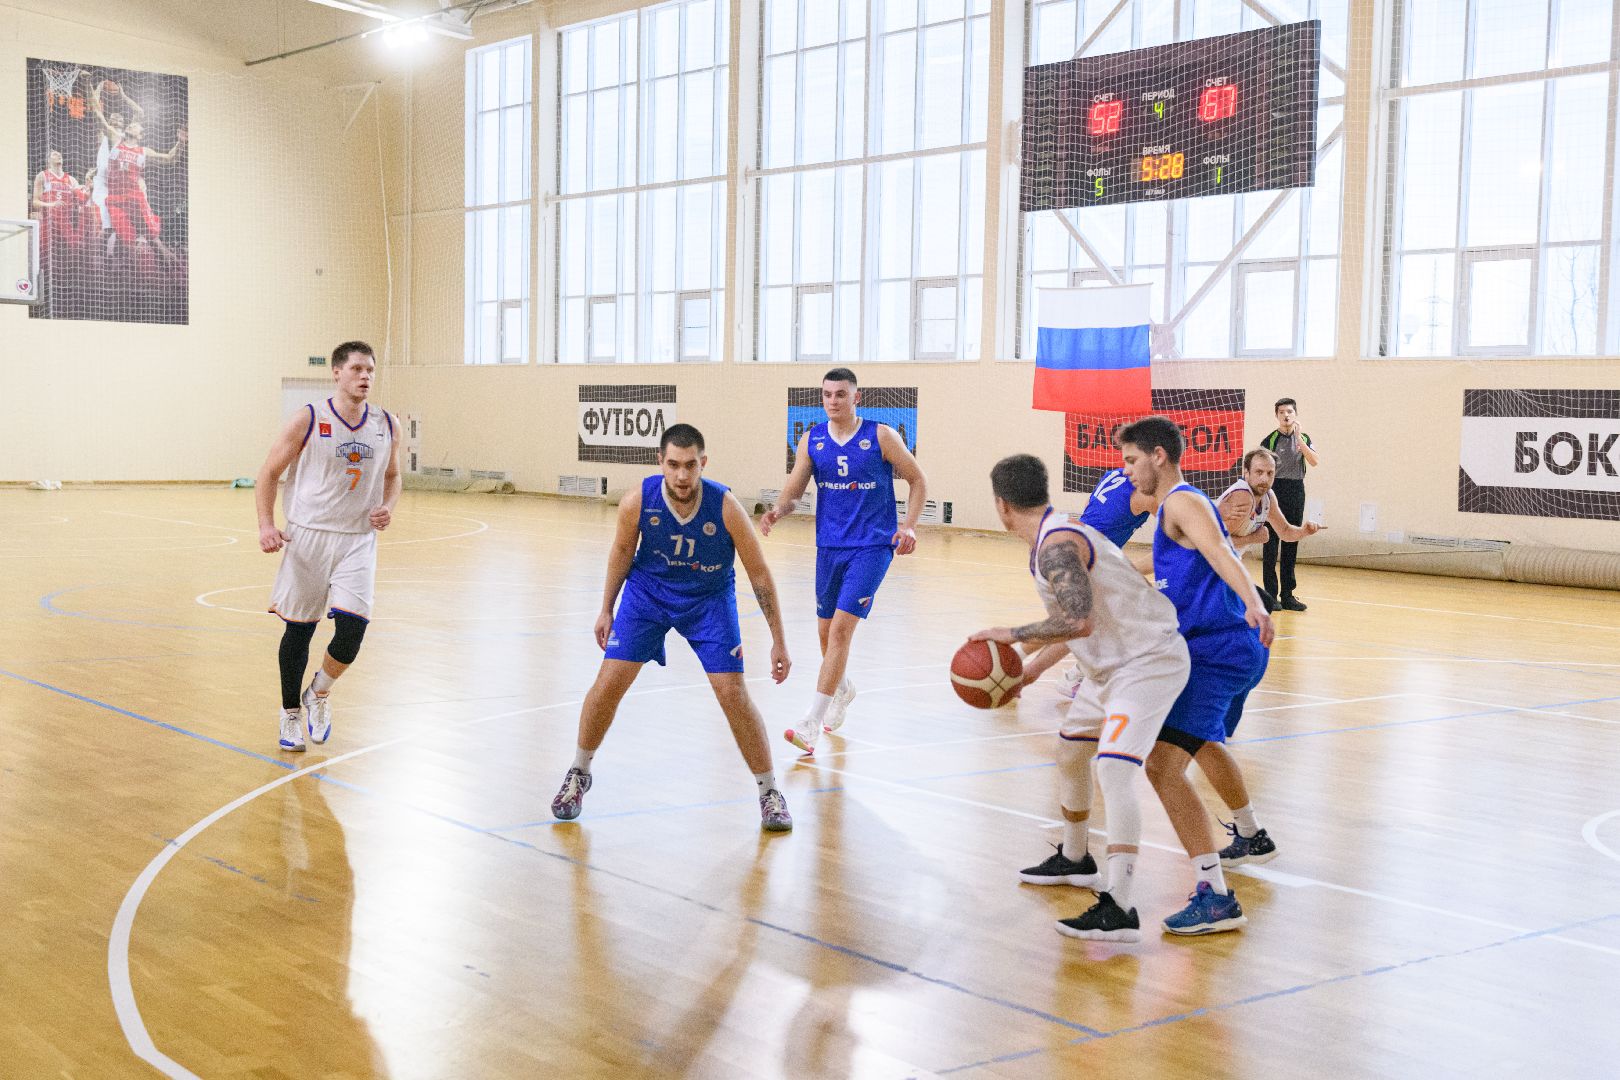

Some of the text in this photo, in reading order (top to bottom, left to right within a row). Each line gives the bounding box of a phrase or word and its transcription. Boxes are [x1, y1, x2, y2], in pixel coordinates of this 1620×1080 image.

[1205, 77, 1228, 87] СЧЕТ
[1094, 93, 1114, 103] СЧЕТ
[1142, 89, 1175, 101] ПЕРИОД
[1203, 86, 1235, 120] 67
[1092, 101, 1121, 134] 52
[1154, 102, 1164, 119] 4
[1142, 145, 1170, 155] ВРЕМЯ
[1203, 154, 1230, 165] ФОЛЫ
[1216, 167, 1221, 183] 1
[1095, 178, 1103, 196] 5
[583, 408, 666, 437] ФУТБОЛ
[1078, 423, 1231, 453] БАСОЛ
[1513, 431, 1620, 477] БОК
[837, 456, 849, 477] 5
[345, 468, 362, 490] 7
[1093, 470, 1127, 504] 12
[670, 535, 695, 557] 71
[1108, 713, 1130, 743] 7
